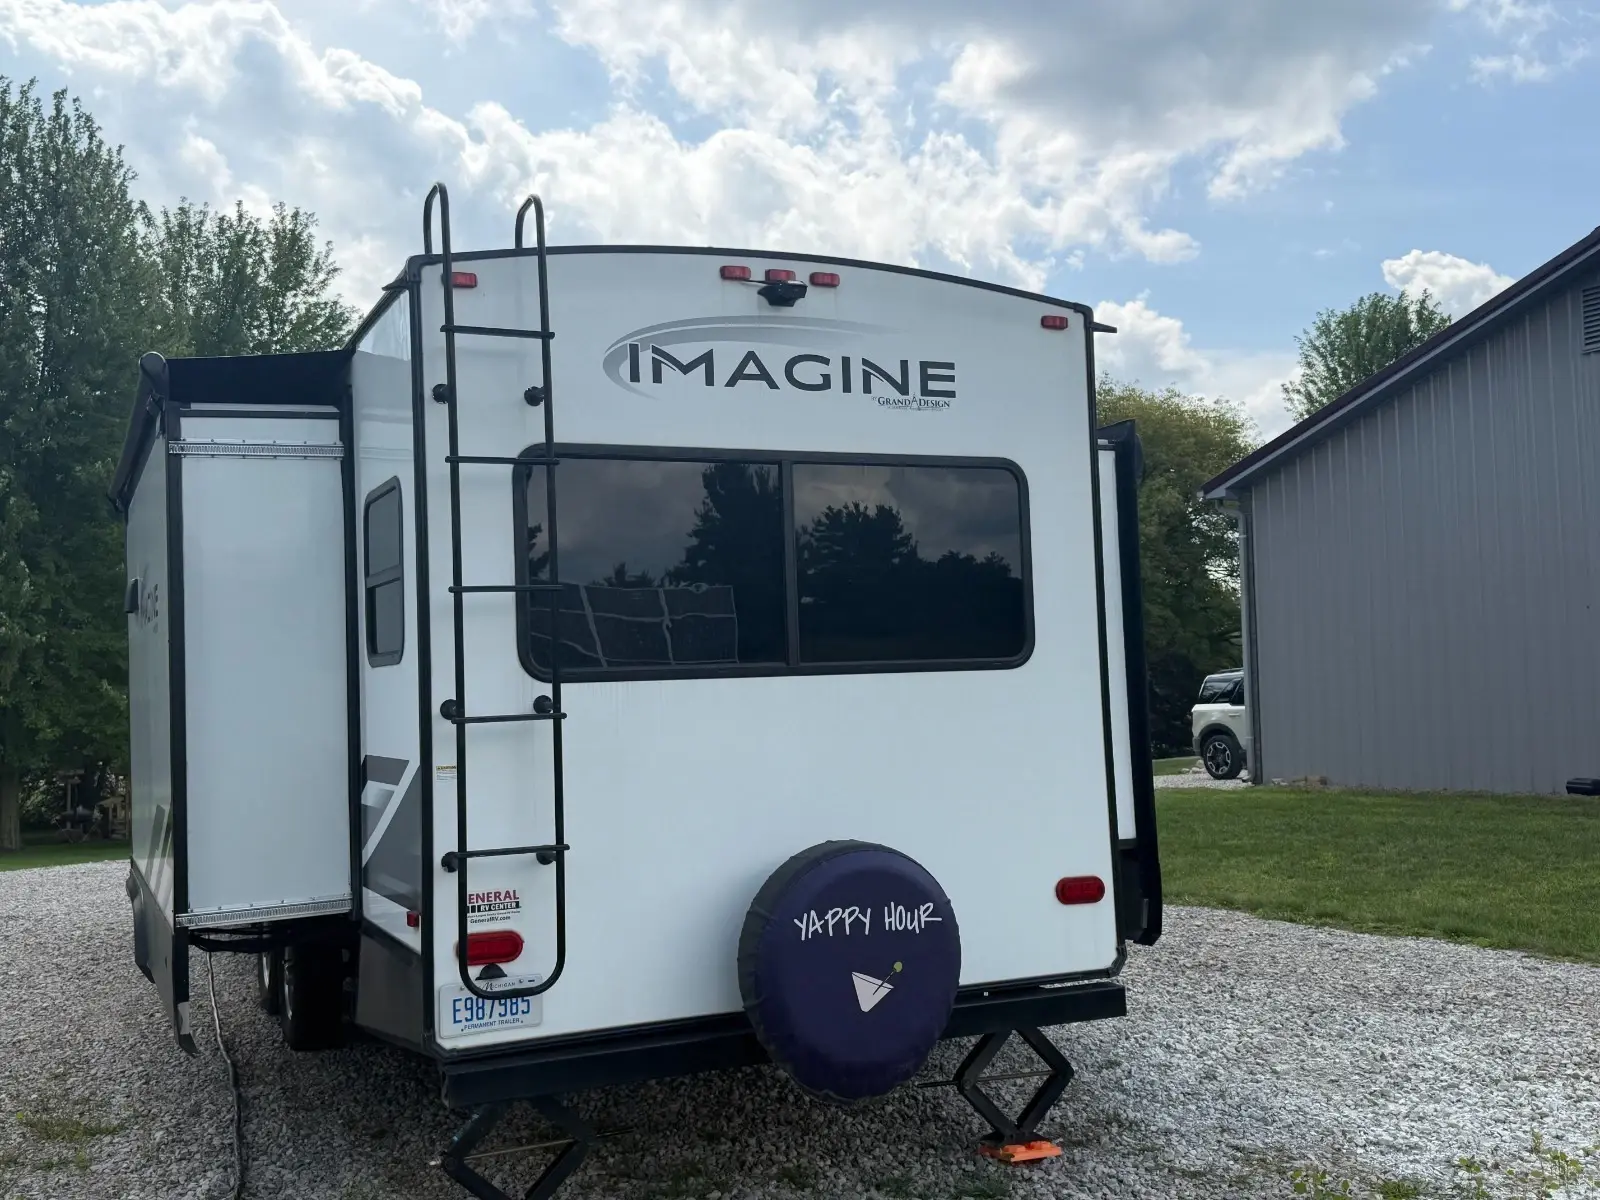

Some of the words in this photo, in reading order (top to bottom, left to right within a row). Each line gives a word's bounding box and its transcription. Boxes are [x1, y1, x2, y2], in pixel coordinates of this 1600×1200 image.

[628, 342, 956, 399] IMAGINE
[877, 396, 911, 406] GRAND
[919, 398, 950, 408] DESIGN
[468, 889, 520, 905] ENERAL
[480, 904, 490, 912] RV
[490, 902, 516, 911] CENTER
[794, 907, 872, 941] YAPPY
[884, 901, 942, 934] HOUR
[452, 996, 531, 1025] E987985
[463, 1021, 496, 1030] PERMANENT
[498, 1018, 520, 1026] TRAILER
